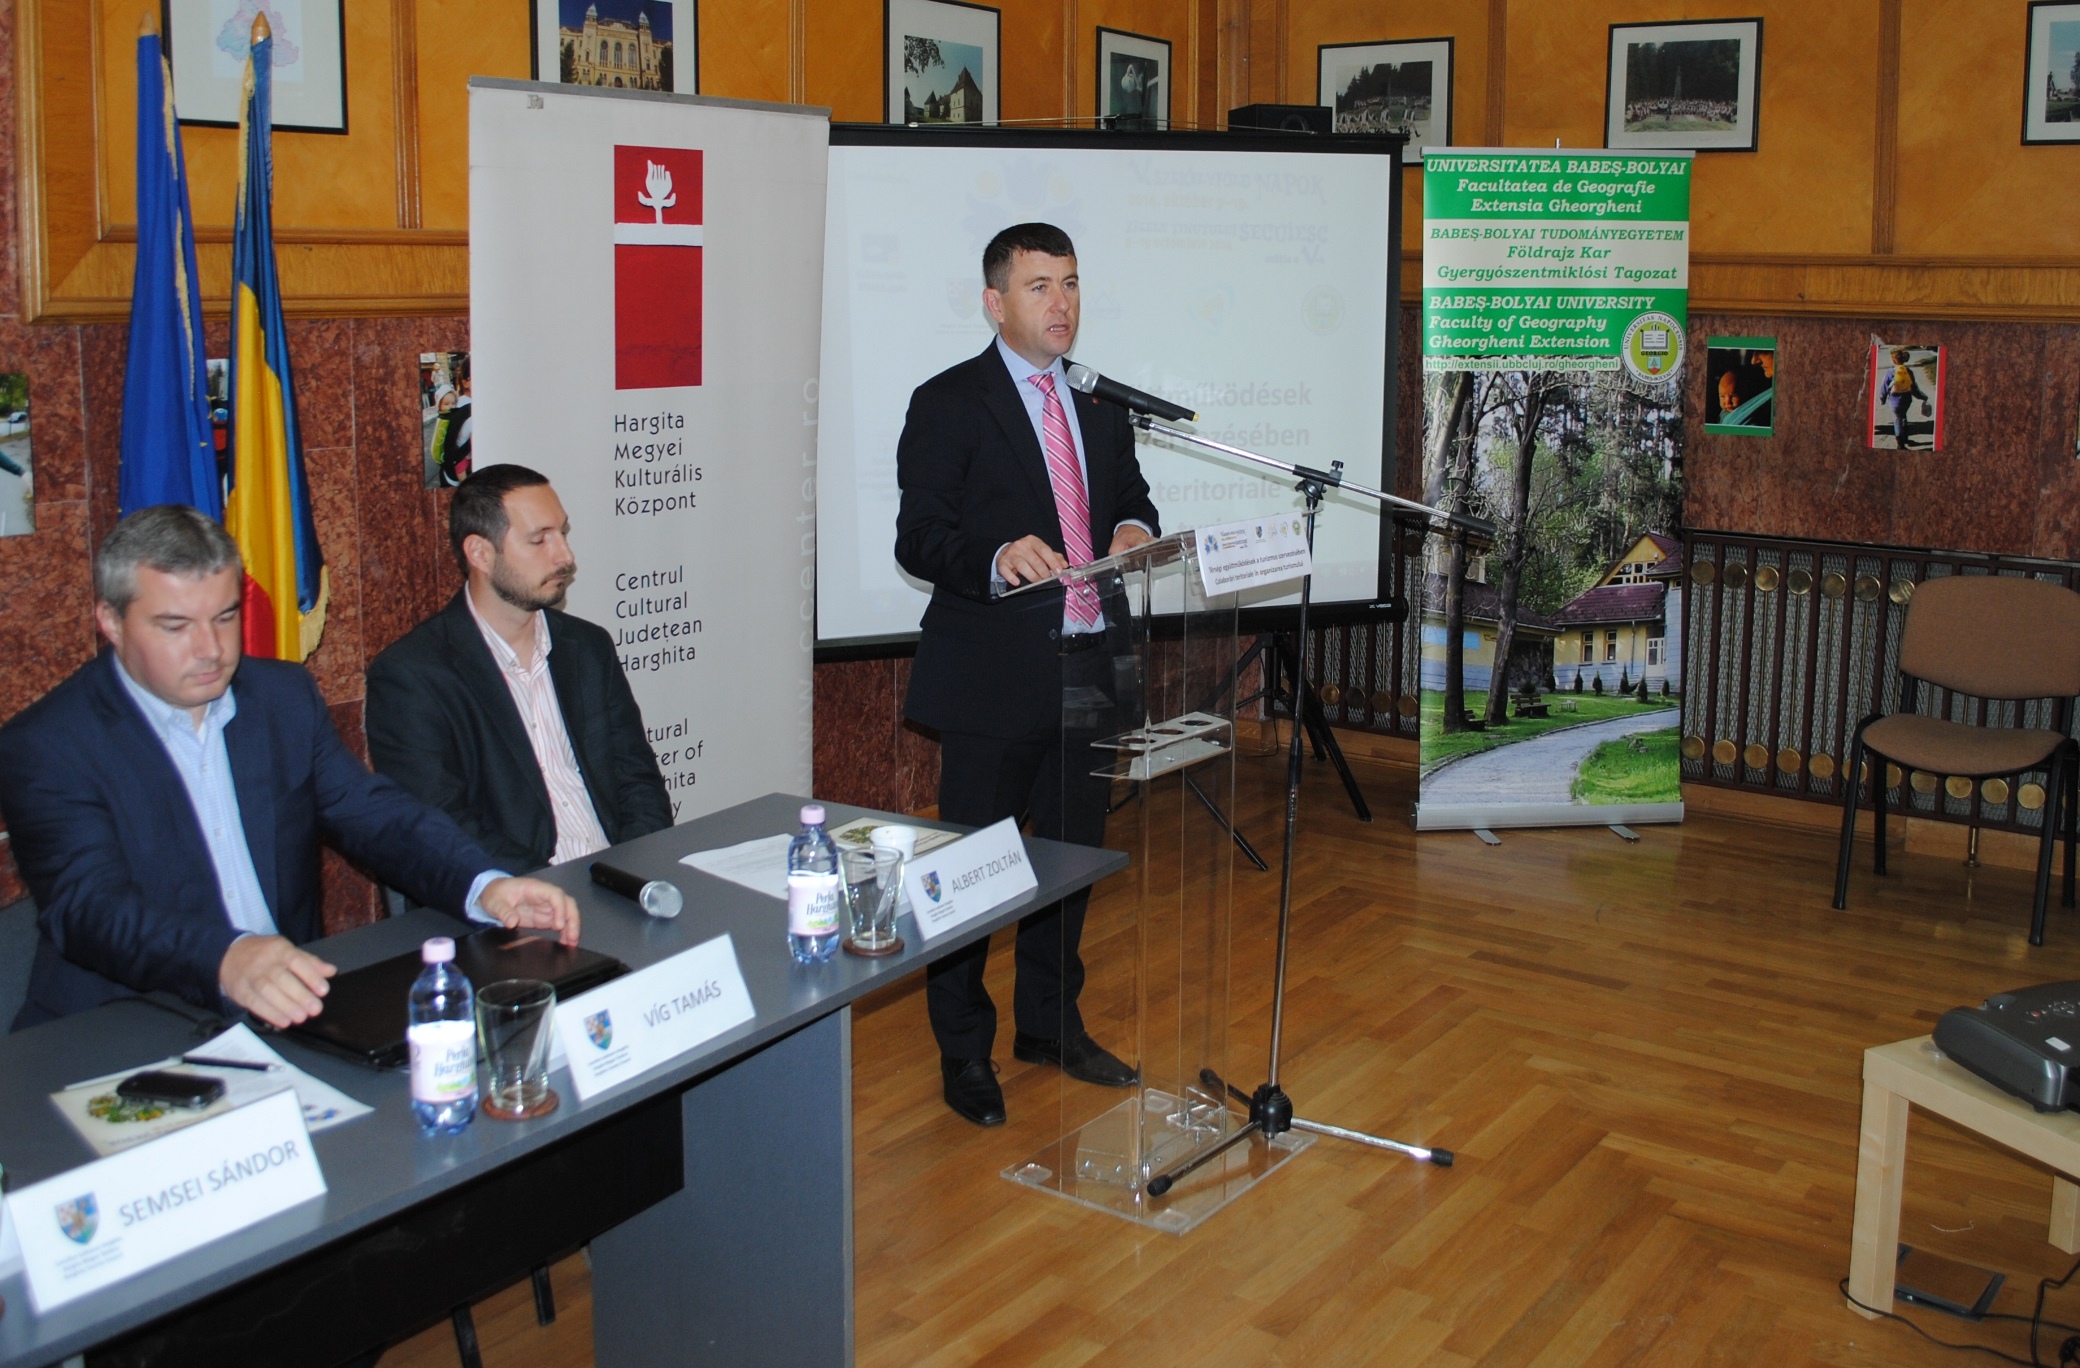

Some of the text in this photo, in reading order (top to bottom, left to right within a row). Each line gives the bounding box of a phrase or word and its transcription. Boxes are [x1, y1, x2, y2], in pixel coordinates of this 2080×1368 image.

[1426, 159, 1561, 173] UNIVERSITATEA
[1457, 178, 1655, 197] Facultatea de Geografie
[1470, 198, 1642, 216] Extensia Gheorgheni
[1540, 225, 1684, 241] TUDOMÁNYEGYETEM
[1507, 246, 1612, 262] Földrajz Kar
[1437, 265, 1678, 282] Gyergyószentmiklósi Tagozat
[1556, 296, 1656, 310] UNIVERSITY
[1428, 315, 1608, 332] Faculty of Geography
[1428, 335, 1611, 351] Gheorgheni Extension
[1425, 360, 1619, 371] http://extensii.ubbcluj.ro/gheorgheni
[615, 411, 684, 435] Hargita
[614, 437, 682, 463] Megyei
[615, 464, 702, 488] Kulturális
[1155, 475, 1281, 502] teritoriale
[615, 491, 696, 517] Központ
[615, 564, 683, 592] Centrul
[616, 590, 688, 619] Cultural
[615, 619, 702, 647] Județean
[617, 645, 696, 672] Harghita
[646, 718, 688, 743] tural
[684, 740, 704, 761] of
[951, 849, 1022, 893] ALBERT ZOLTÁN
[642, 979, 722, 1028] VÍG TAMÁS
[118, 1138, 301, 1228] SEMSEI SÁNDOR
